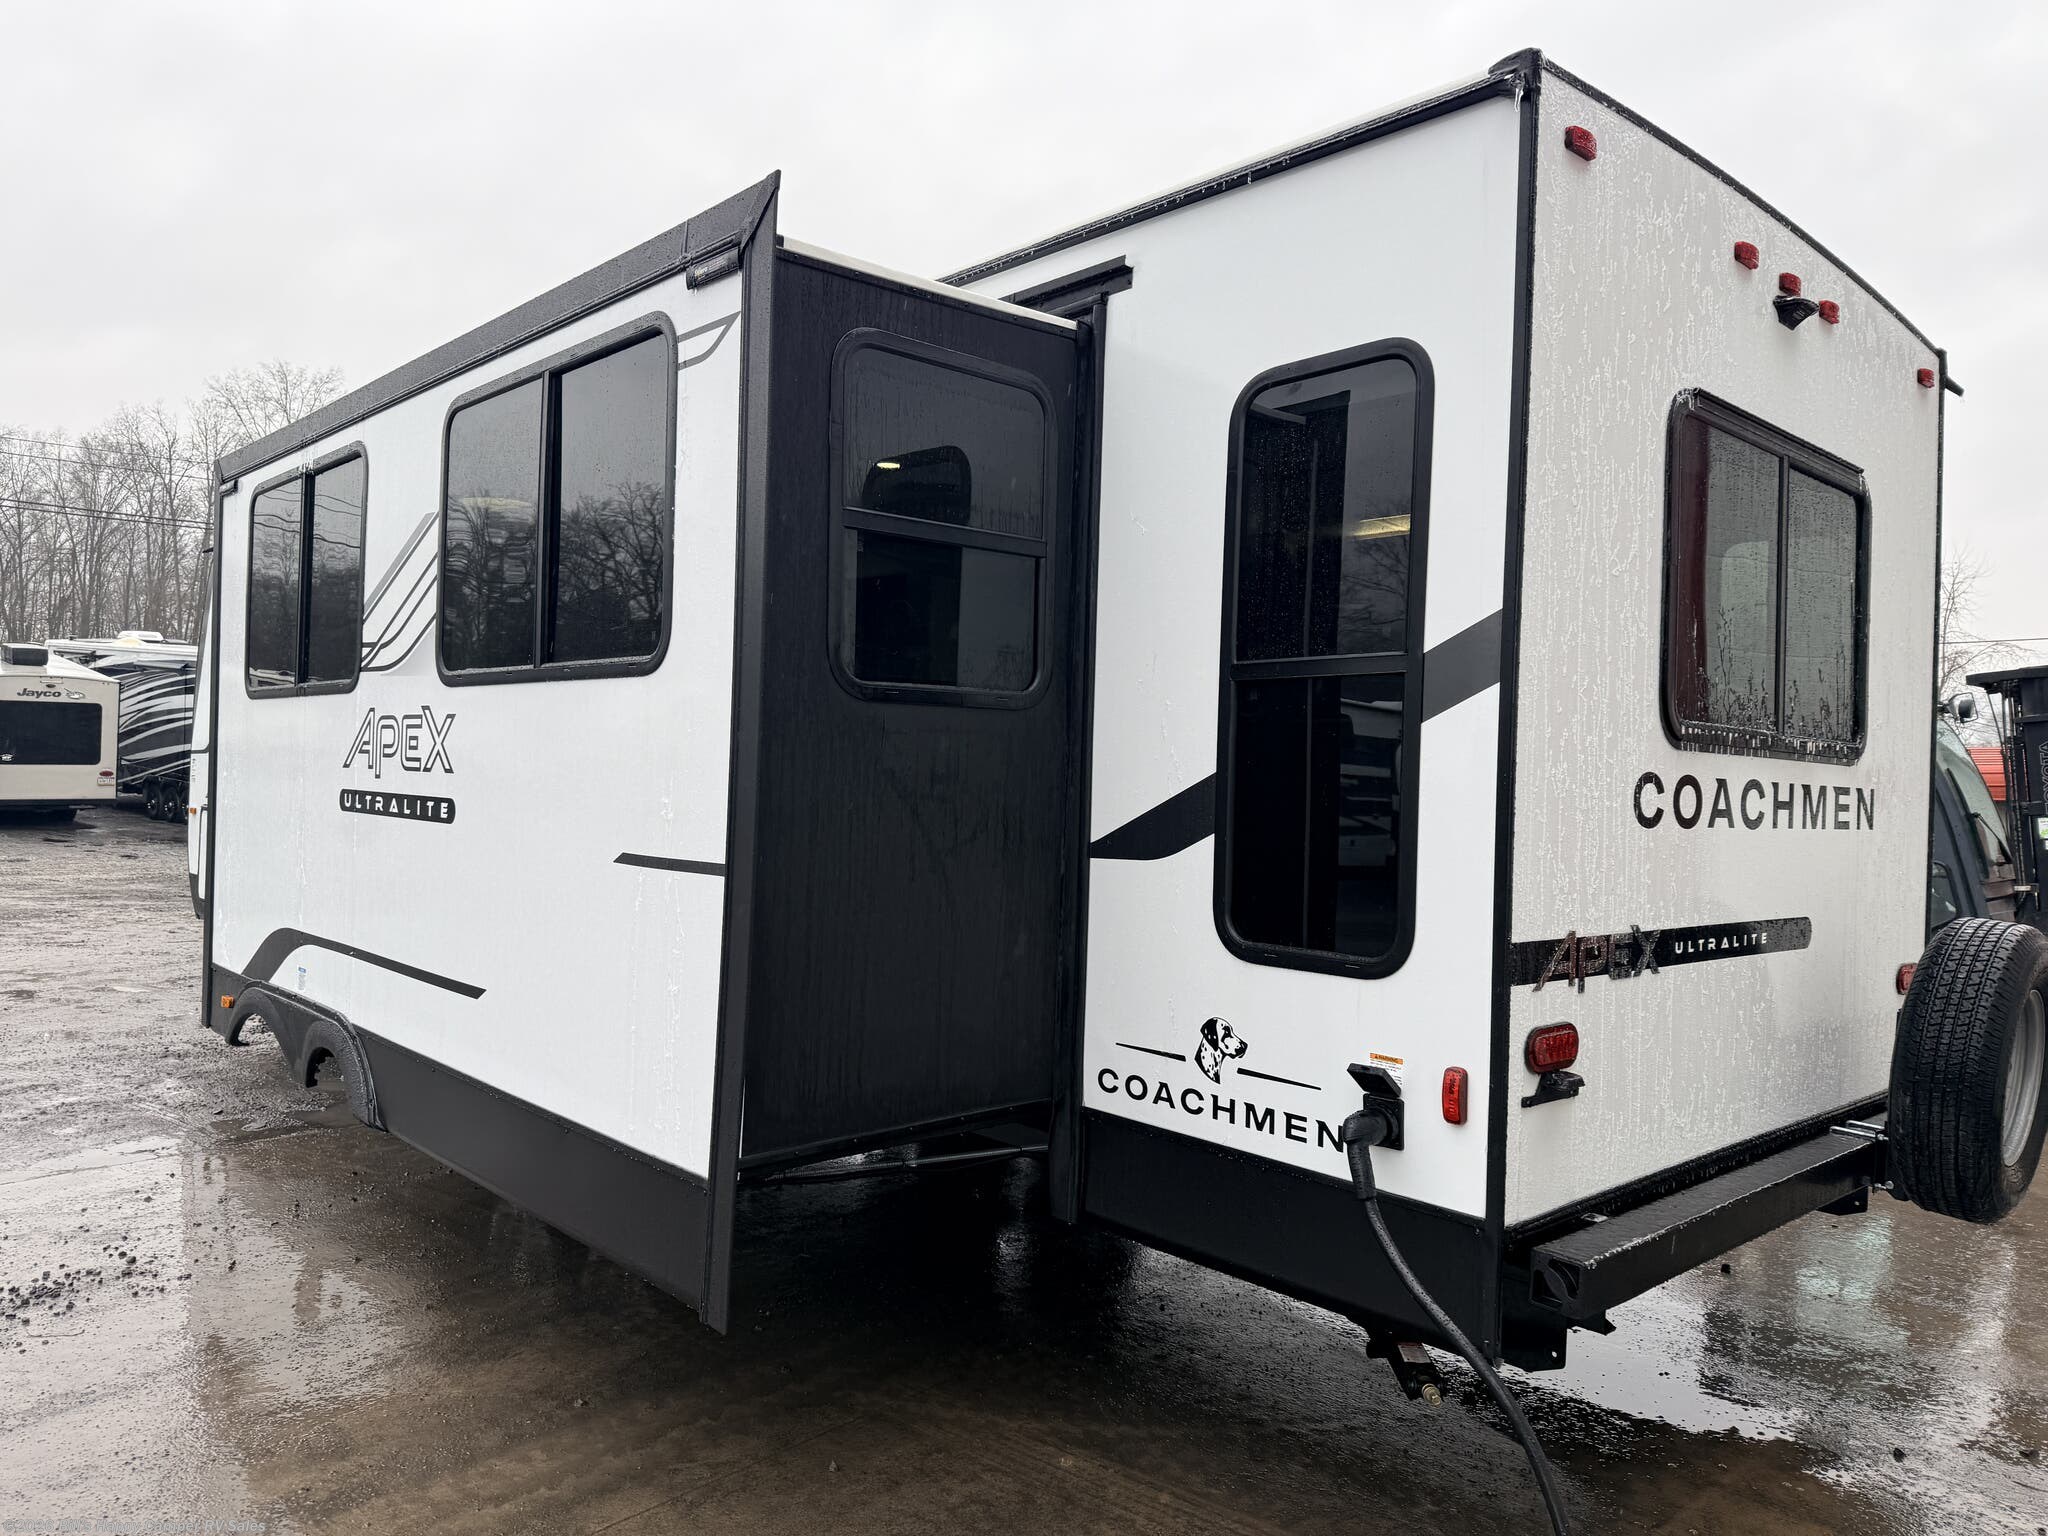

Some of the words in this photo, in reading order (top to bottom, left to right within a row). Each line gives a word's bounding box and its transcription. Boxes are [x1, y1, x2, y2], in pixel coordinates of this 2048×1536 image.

[16, 688, 62, 699] Jayco
[342, 705, 457, 779] APEX
[343, 793, 449, 819] ULTRALITE
[1633, 771, 1875, 831] COACHMEN
[2038, 740, 2048, 815] YOTA
[1532, 924, 1661, 994] APEX
[1675, 932, 1768, 954] ULTRALITE
[1097, 1068, 1344, 1153] COACHMEN
